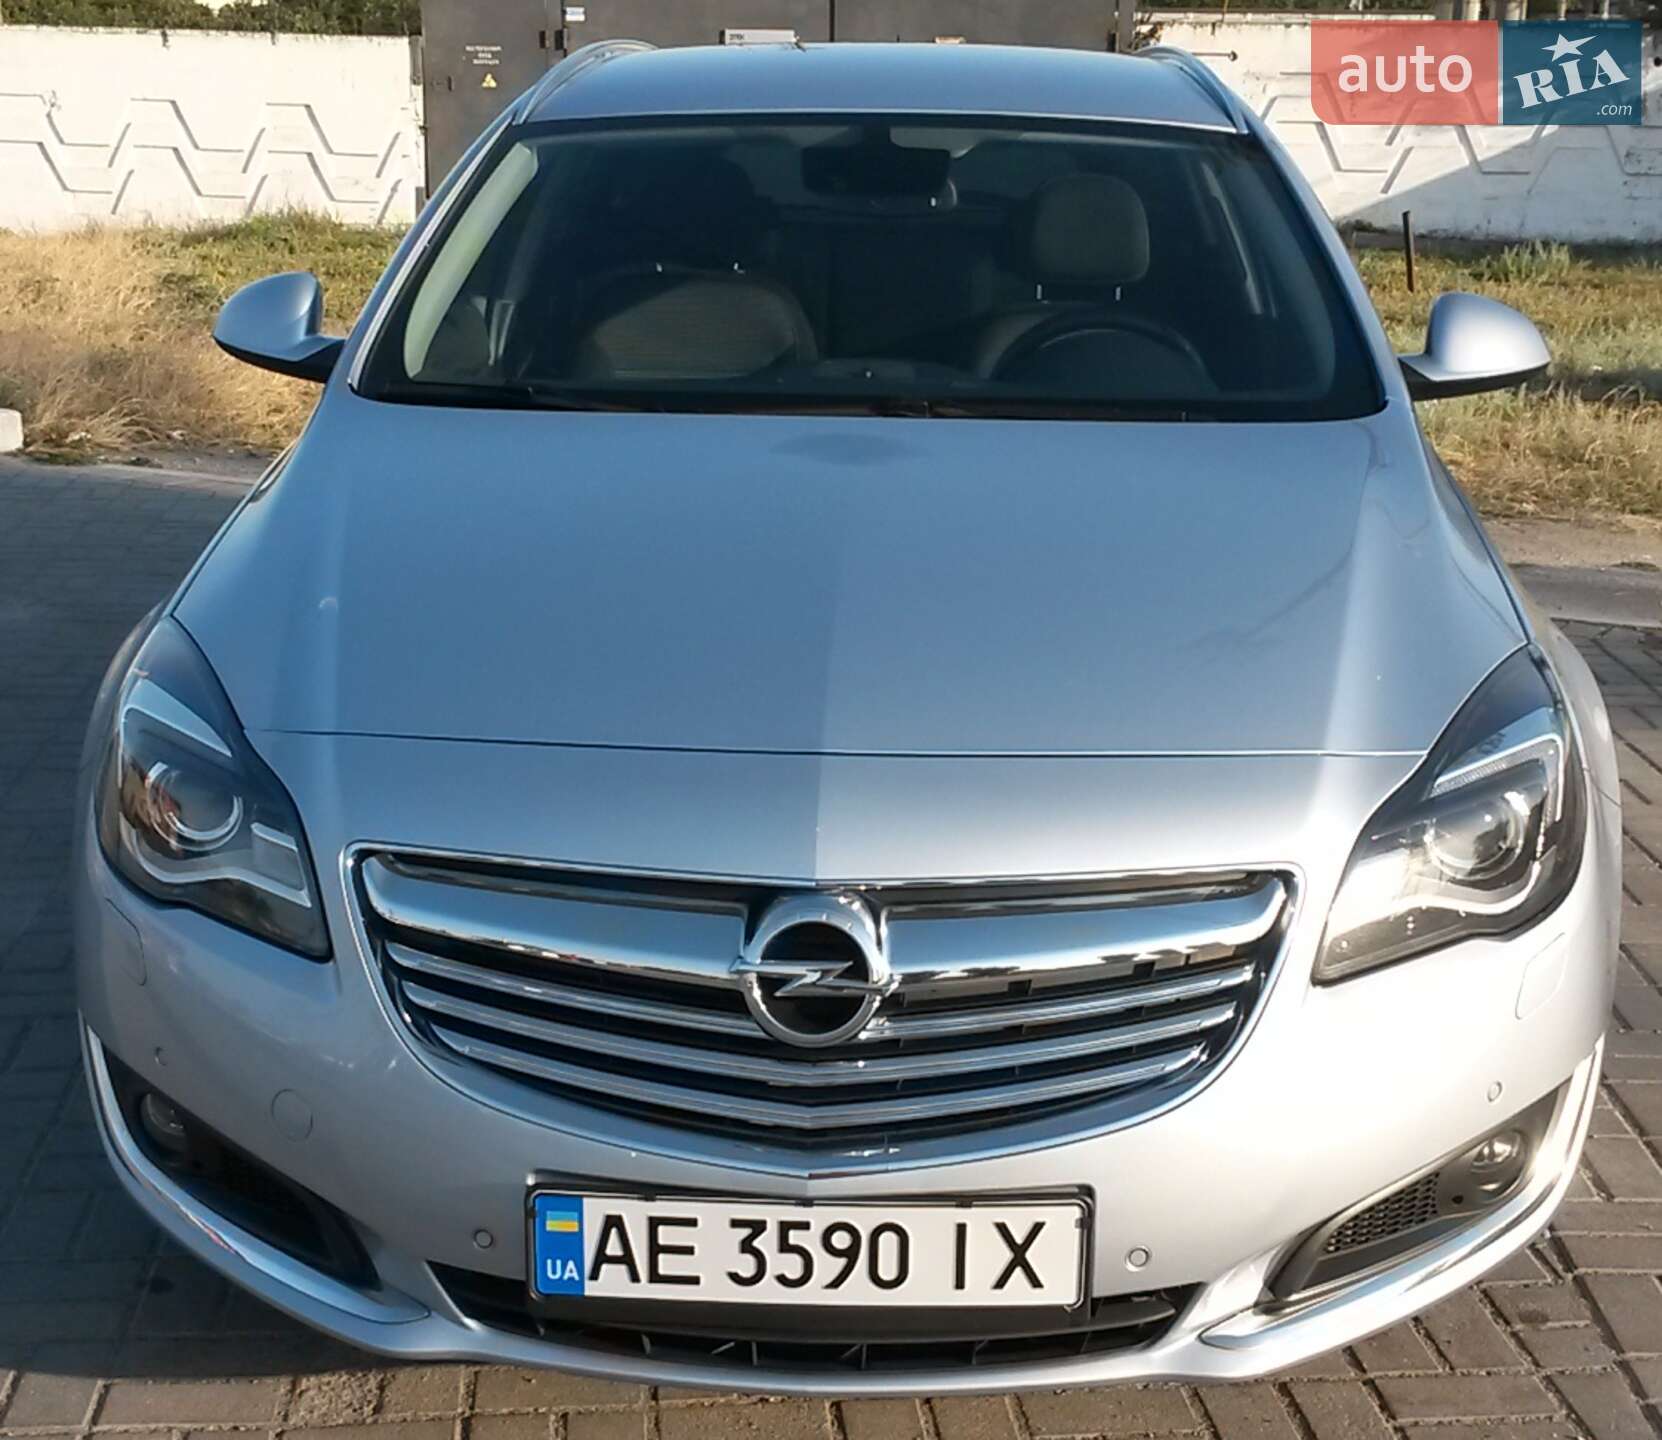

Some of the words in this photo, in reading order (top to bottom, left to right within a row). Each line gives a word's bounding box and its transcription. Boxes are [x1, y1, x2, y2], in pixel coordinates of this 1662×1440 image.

[546, 1257, 579, 1281] UA
[588, 1214, 701, 1286] AE
[726, 1218, 911, 1290] 3590
